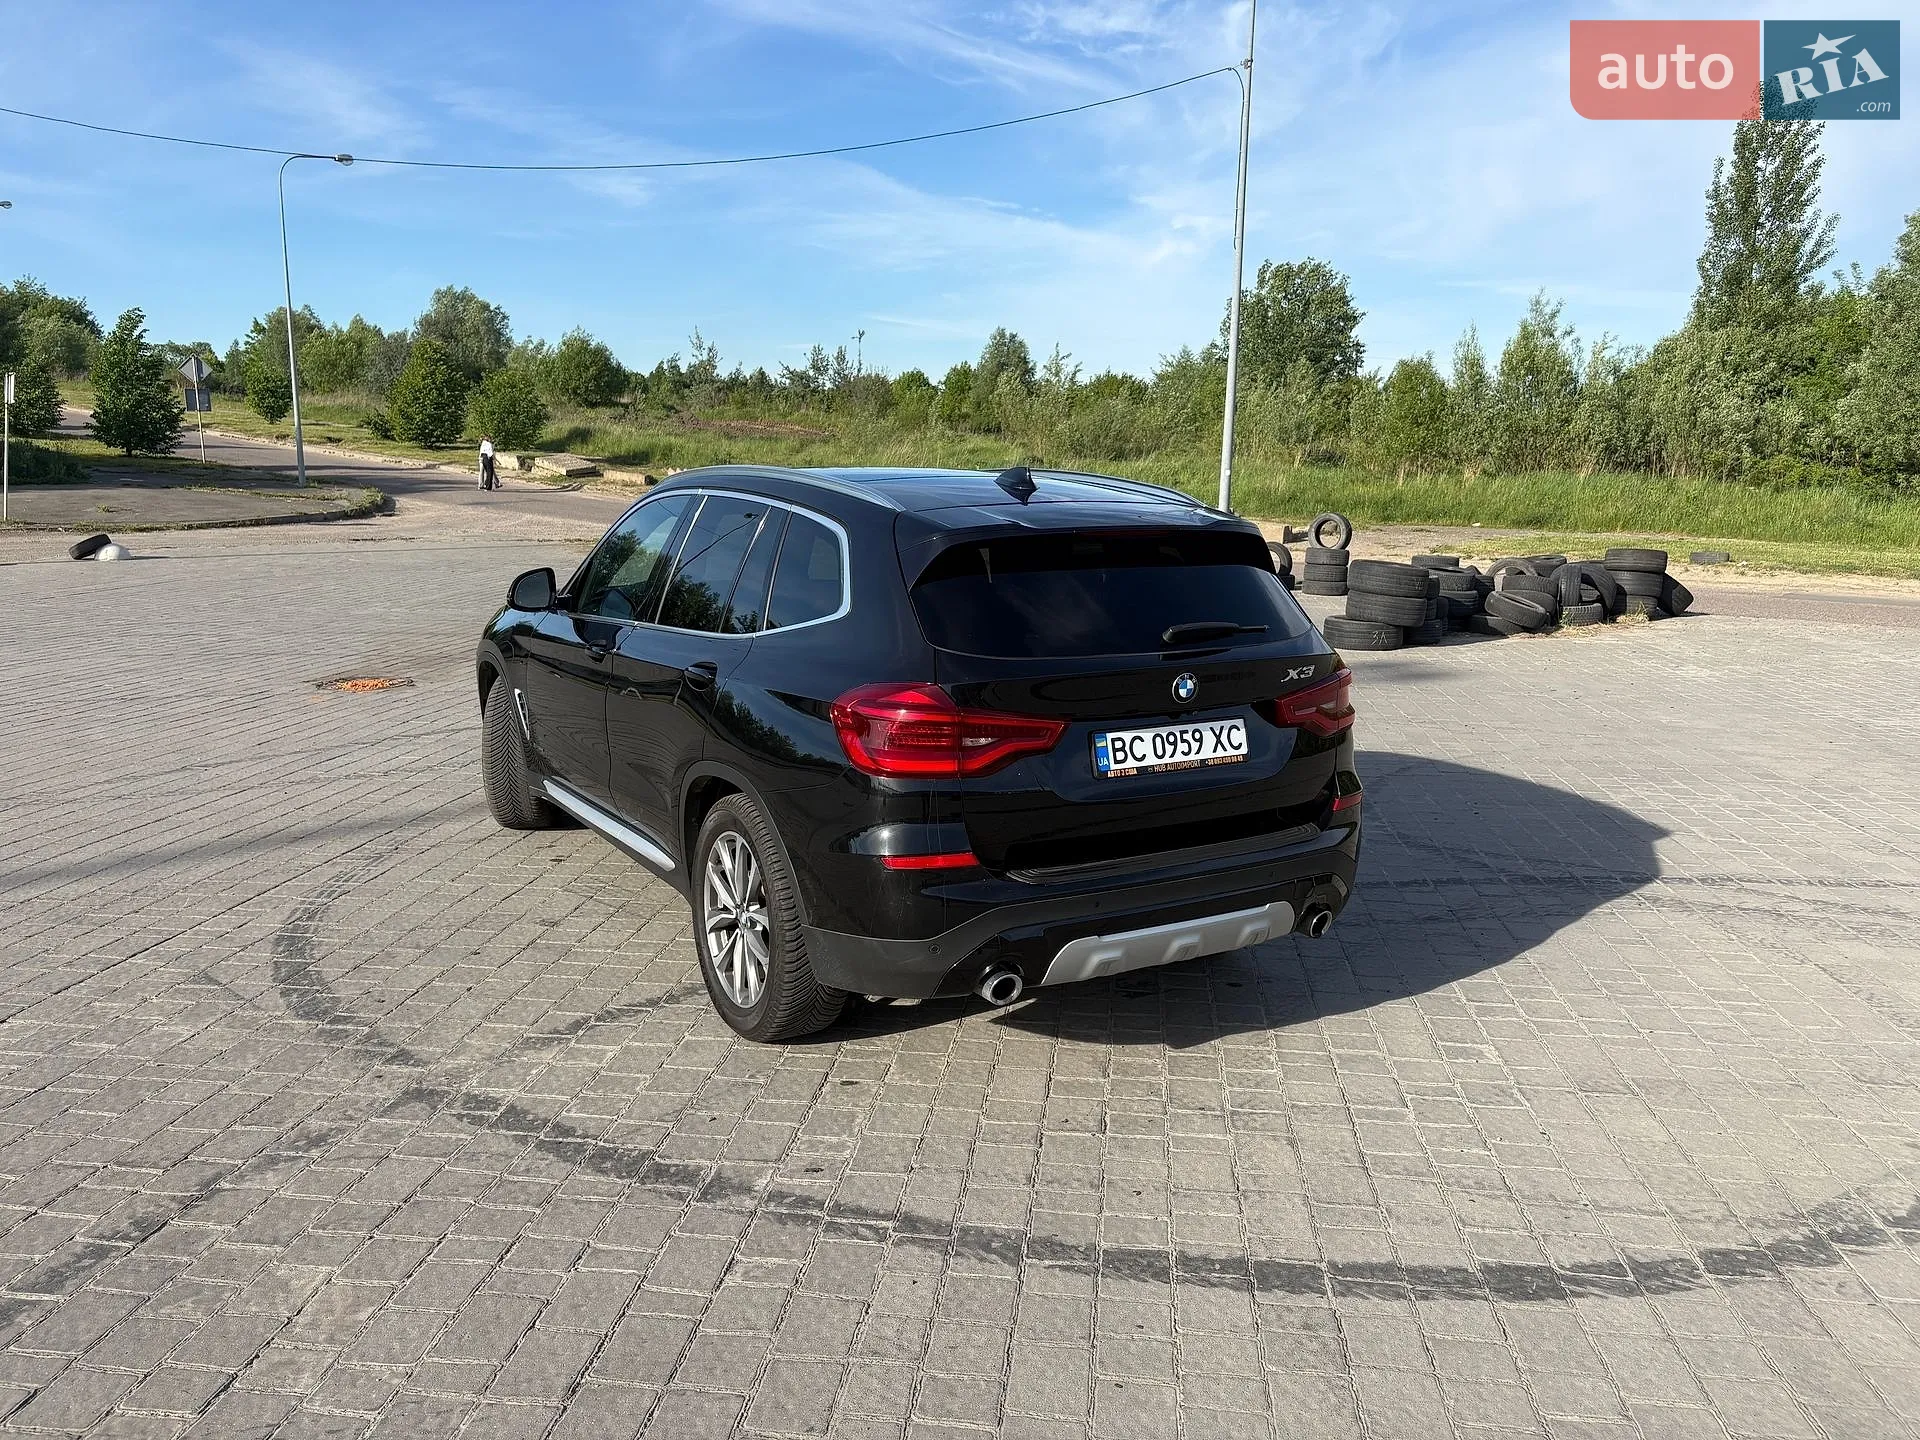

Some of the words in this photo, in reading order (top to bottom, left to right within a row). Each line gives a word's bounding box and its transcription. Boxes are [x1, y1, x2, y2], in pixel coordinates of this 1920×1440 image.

[1281, 665, 1315, 682] X3
[1111, 735, 1146, 764] BC
[1152, 728, 1204, 759] 0959
[1209, 725, 1243, 753] XC
[1097, 757, 1109, 766] UA
